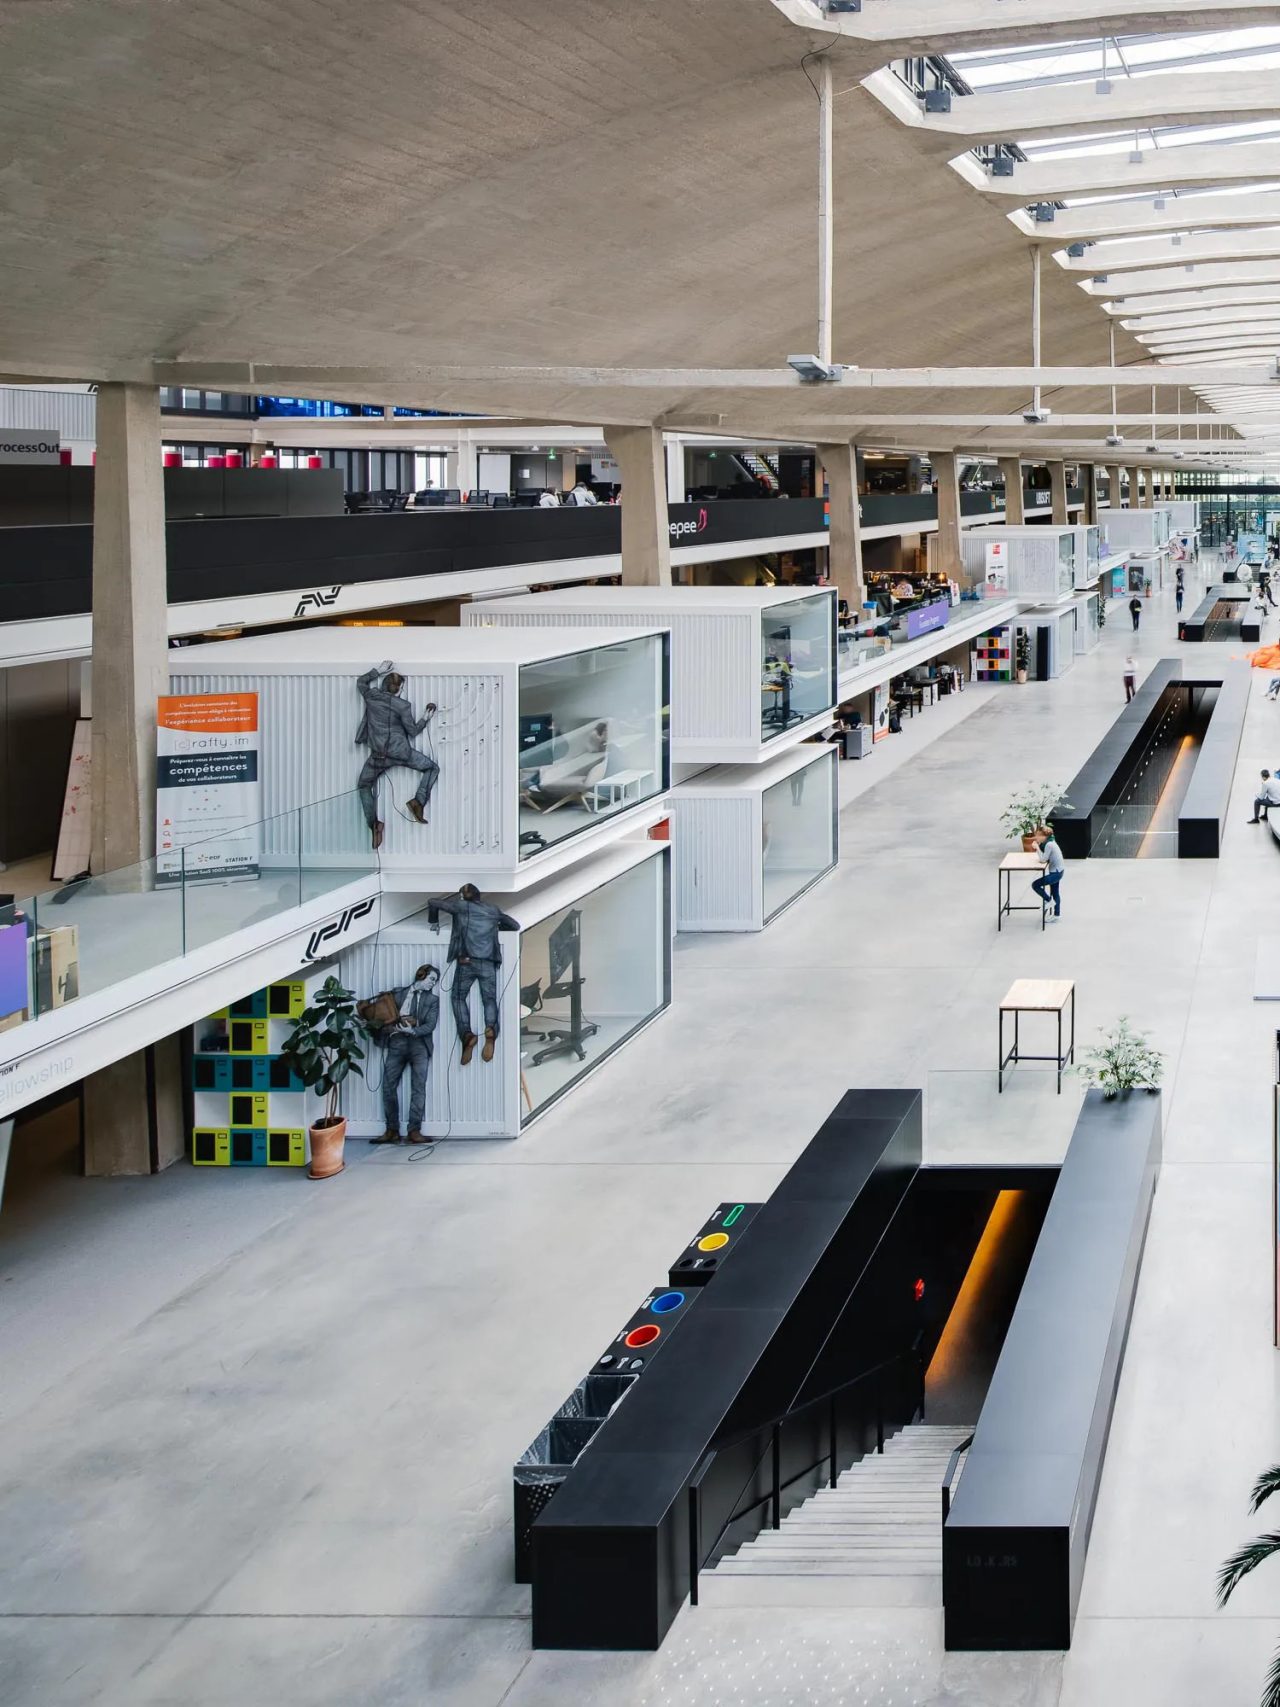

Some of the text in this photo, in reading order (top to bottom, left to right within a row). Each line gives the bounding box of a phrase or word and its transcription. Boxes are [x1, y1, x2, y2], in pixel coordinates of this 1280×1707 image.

[0, 443, 60, 453] rocessOut
[667, 521, 697, 539] epee
[169, 763, 248, 777] compétences
[197, 774, 237, 782] collaborateurs
[0, 1057, 73, 1102] ellowship
[966, 1554, 1017, 1569] LOKRS
